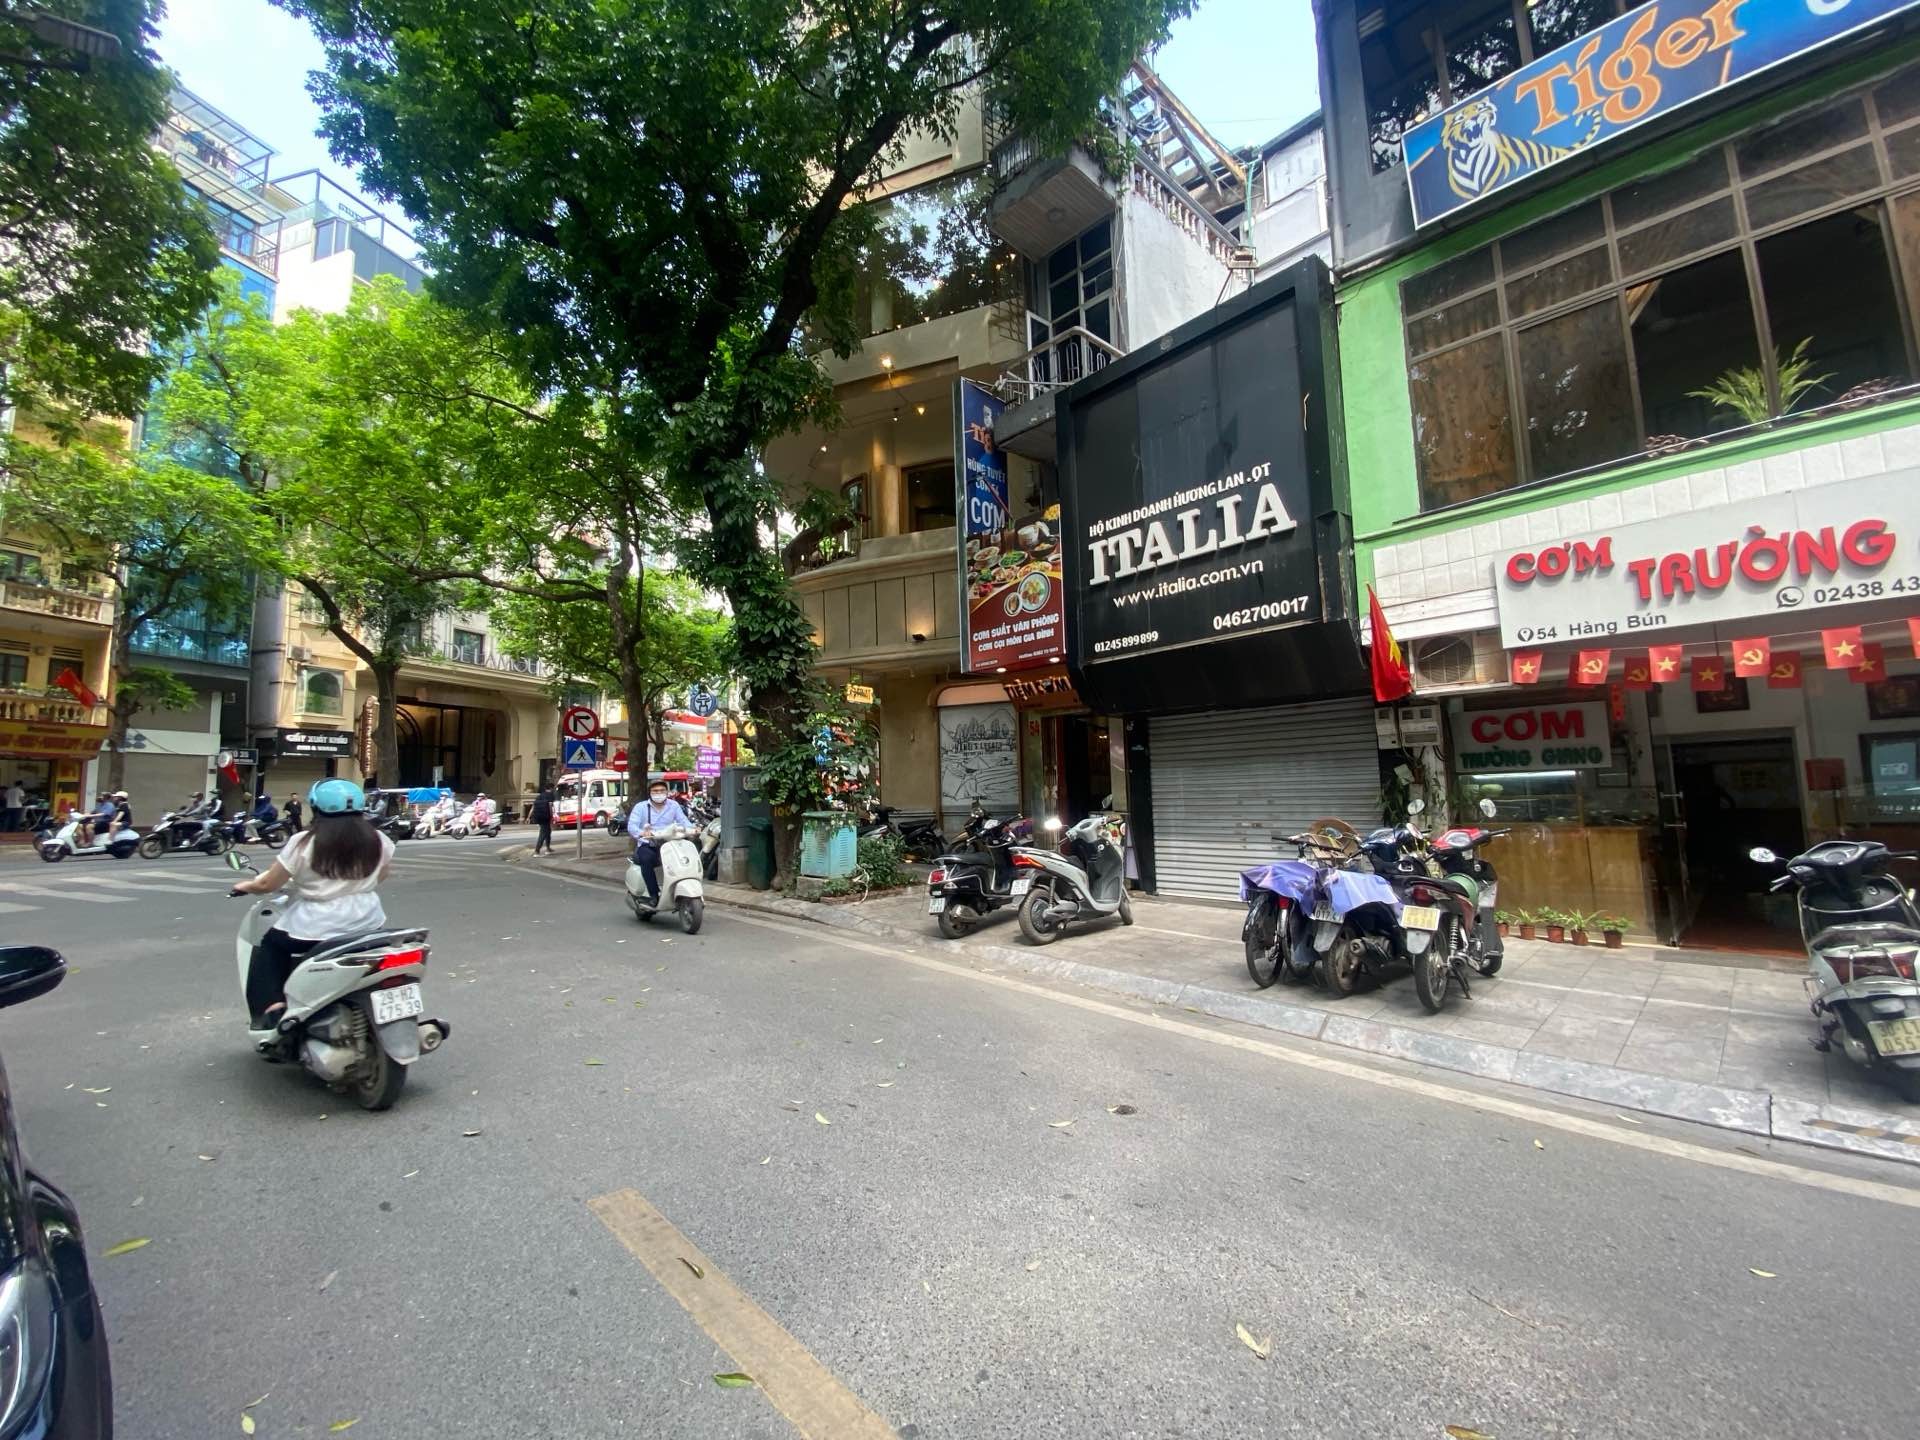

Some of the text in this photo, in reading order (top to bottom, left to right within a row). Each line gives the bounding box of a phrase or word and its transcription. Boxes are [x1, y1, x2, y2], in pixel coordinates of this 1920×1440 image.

[1089, 520, 1104, 537] HỘ
[1105, 512, 1132, 531] KINH
[1133, 497, 1172, 521] DOANH
[1218, 471, 1244, 493] LAN
[1088, 483, 1297, 586] ITALIA
[1507, 519, 1896, 601] CƠM TRƯỜNG
[1113, 559, 1263, 608] www.italia.com.vn
[1814, 581, 1884, 603] 02438
[1213, 596, 1309, 630] 0462700017
[1537, 612, 1667, 640] 54 Hàng Bún
[1472, 710, 1585, 743] CƠM
